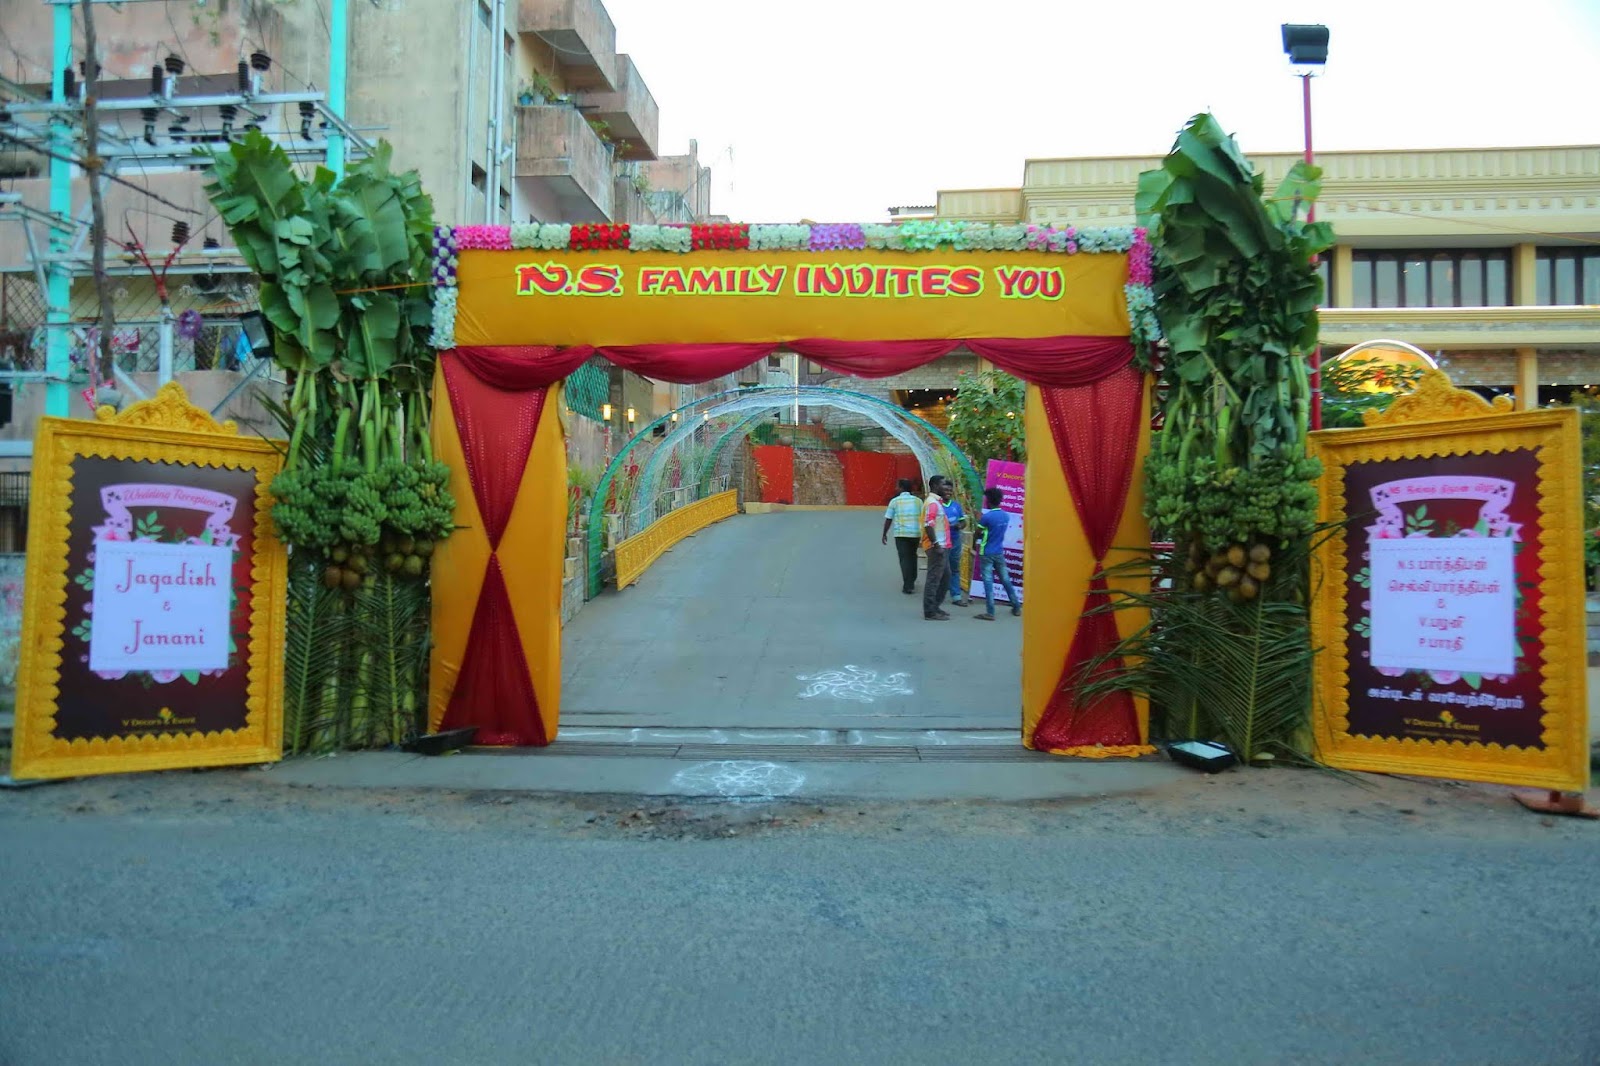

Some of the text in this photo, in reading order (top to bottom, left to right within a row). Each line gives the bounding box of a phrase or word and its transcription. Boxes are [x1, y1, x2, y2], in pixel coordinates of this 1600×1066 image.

[517, 262, 1066, 301] N.S. FAMILY INVITES YOU
[123, 486, 219, 508] Wedding Reception
[124, 619, 206, 655] Janani
